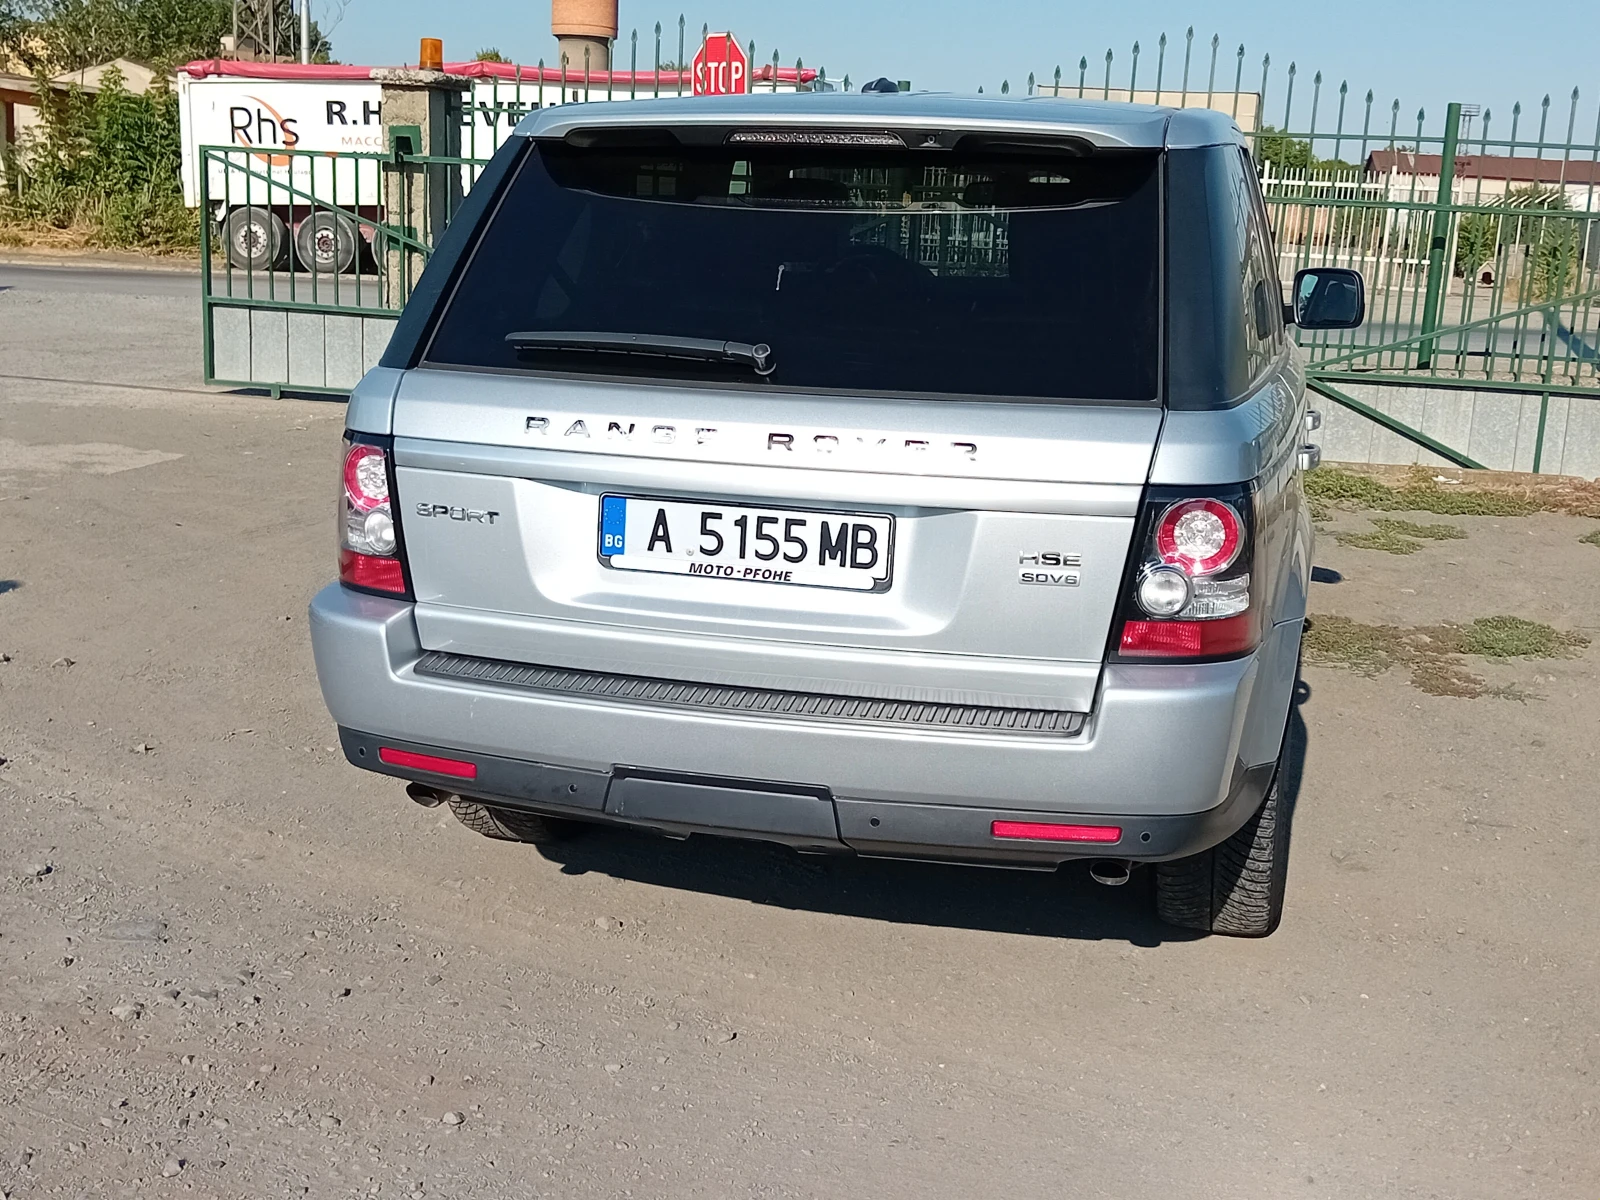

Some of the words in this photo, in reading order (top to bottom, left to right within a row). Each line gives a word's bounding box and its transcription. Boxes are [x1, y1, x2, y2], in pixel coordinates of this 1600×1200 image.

[696, 61, 743, 93] STOP
[230, 106, 300, 146] Rhs
[524, 416, 718, 446] RANGE
[416, 502, 499, 524] SPORT
[605, 534, 623, 548] BG
[647, 508, 673, 553] A
[699, 511, 808, 564] 5155
[818, 520, 879, 570] MB
[1019, 550, 1082, 567] HSE
[1021, 572, 1078, 585] SDV6
